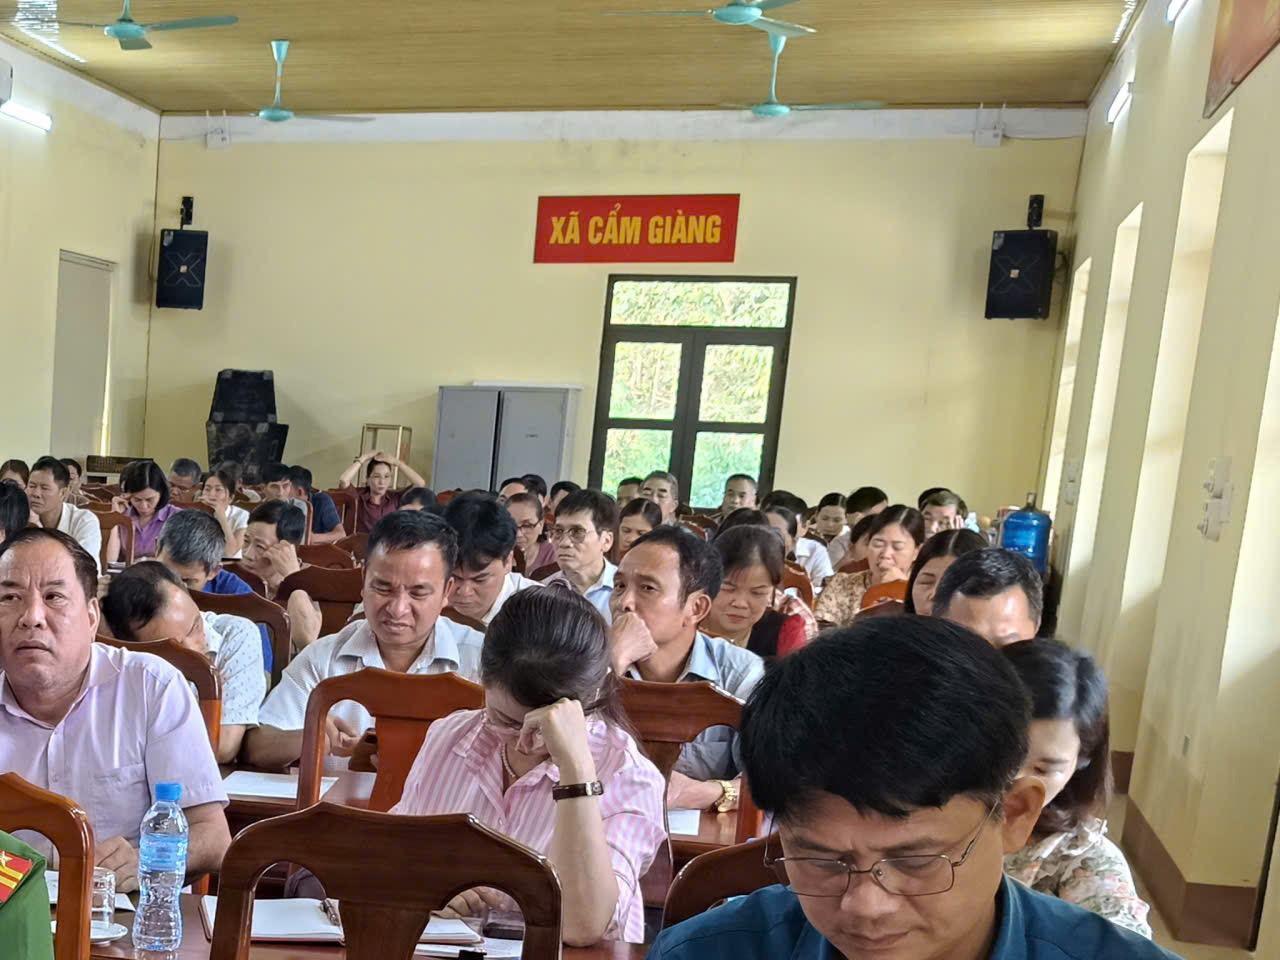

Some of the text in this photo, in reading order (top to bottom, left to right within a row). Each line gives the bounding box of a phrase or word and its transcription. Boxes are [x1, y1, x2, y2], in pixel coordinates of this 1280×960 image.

[549, 203, 722, 245] XÃ CẨM GIÀNG
